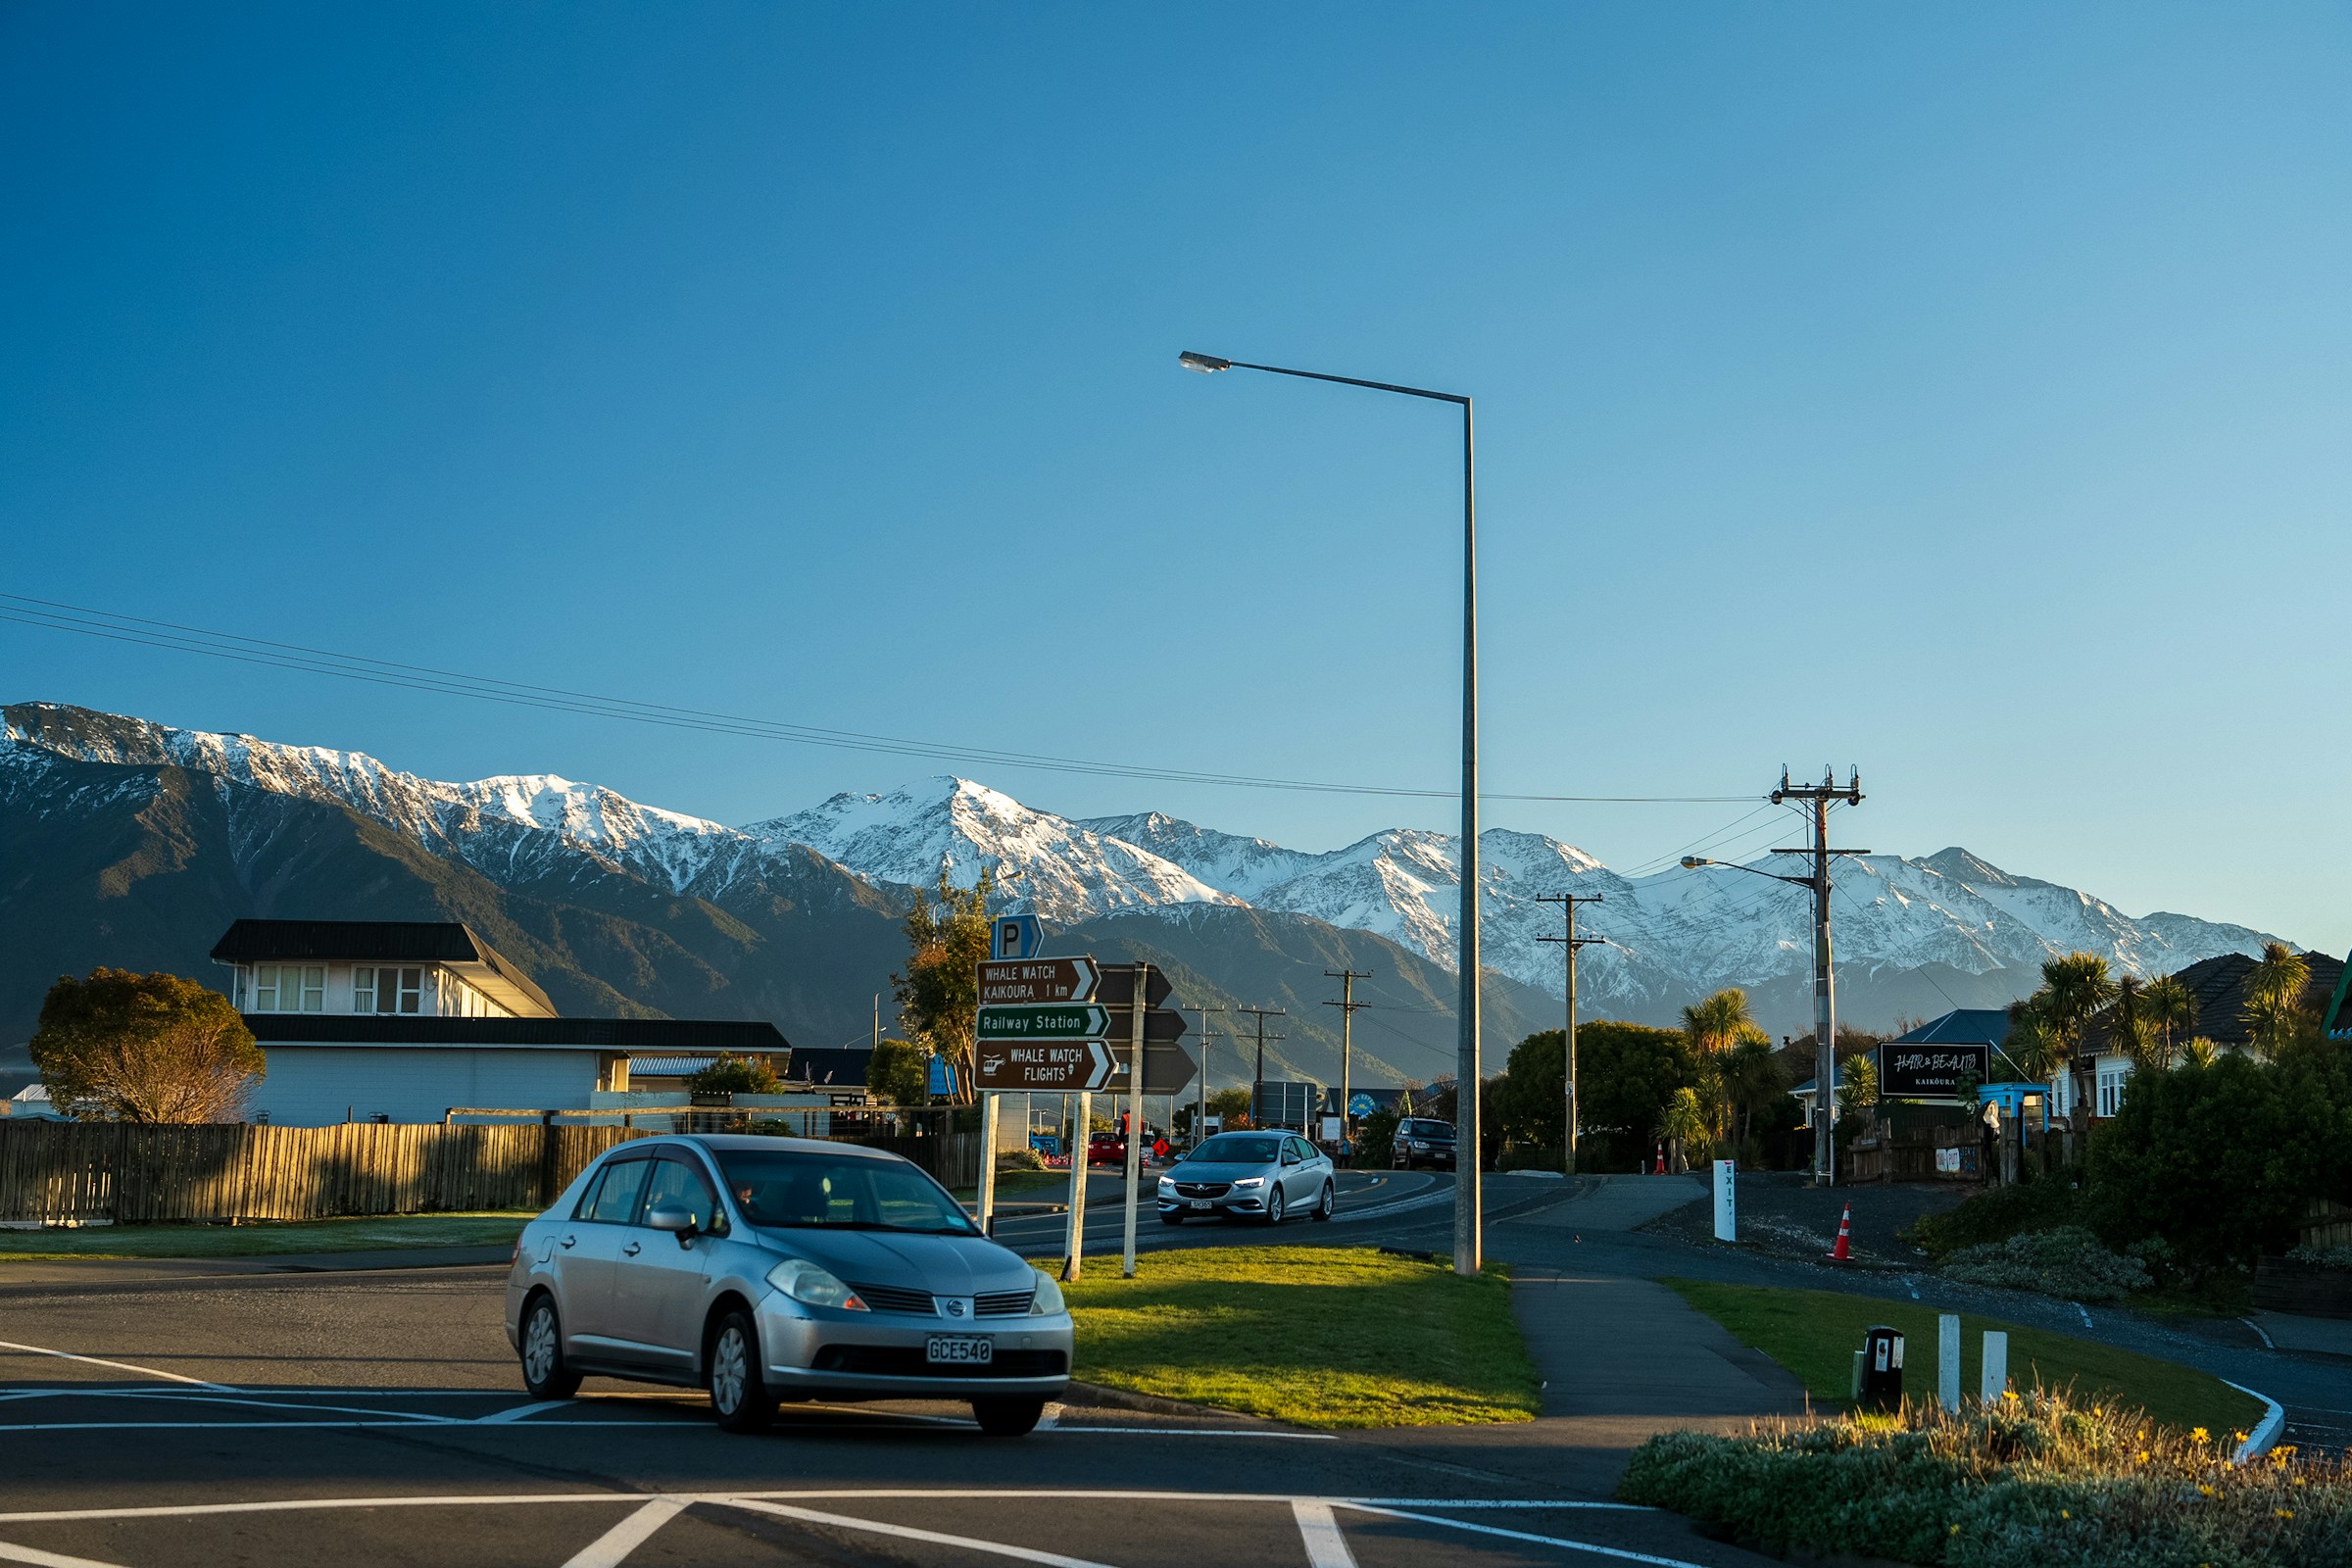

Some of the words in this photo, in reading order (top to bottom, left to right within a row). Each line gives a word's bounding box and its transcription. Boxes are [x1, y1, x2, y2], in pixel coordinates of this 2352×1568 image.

[1004, 924, 1019, 955] P
[985, 966, 1017, 980] WHALE
[1022, 965, 1055, 979] WATCH
[984, 984, 1035, 999] KAIKOURA
[1046, 984, 1051, 997] 1
[1054, 984, 1068, 997] km
[983, 1015, 1030, 1032] Railway
[1036, 1015, 1081, 1029] Station
[1010, 1048, 1045, 1062] WHALE
[1050, 1048, 1083, 1062] WATCH
[1893, 1054, 1925, 1072] HAIR
[1932, 1054, 1977, 1072] BEAUTY
[1024, 1066, 1066, 1081] FLIGHTS
[930, 1341, 990, 1360] GCE540
